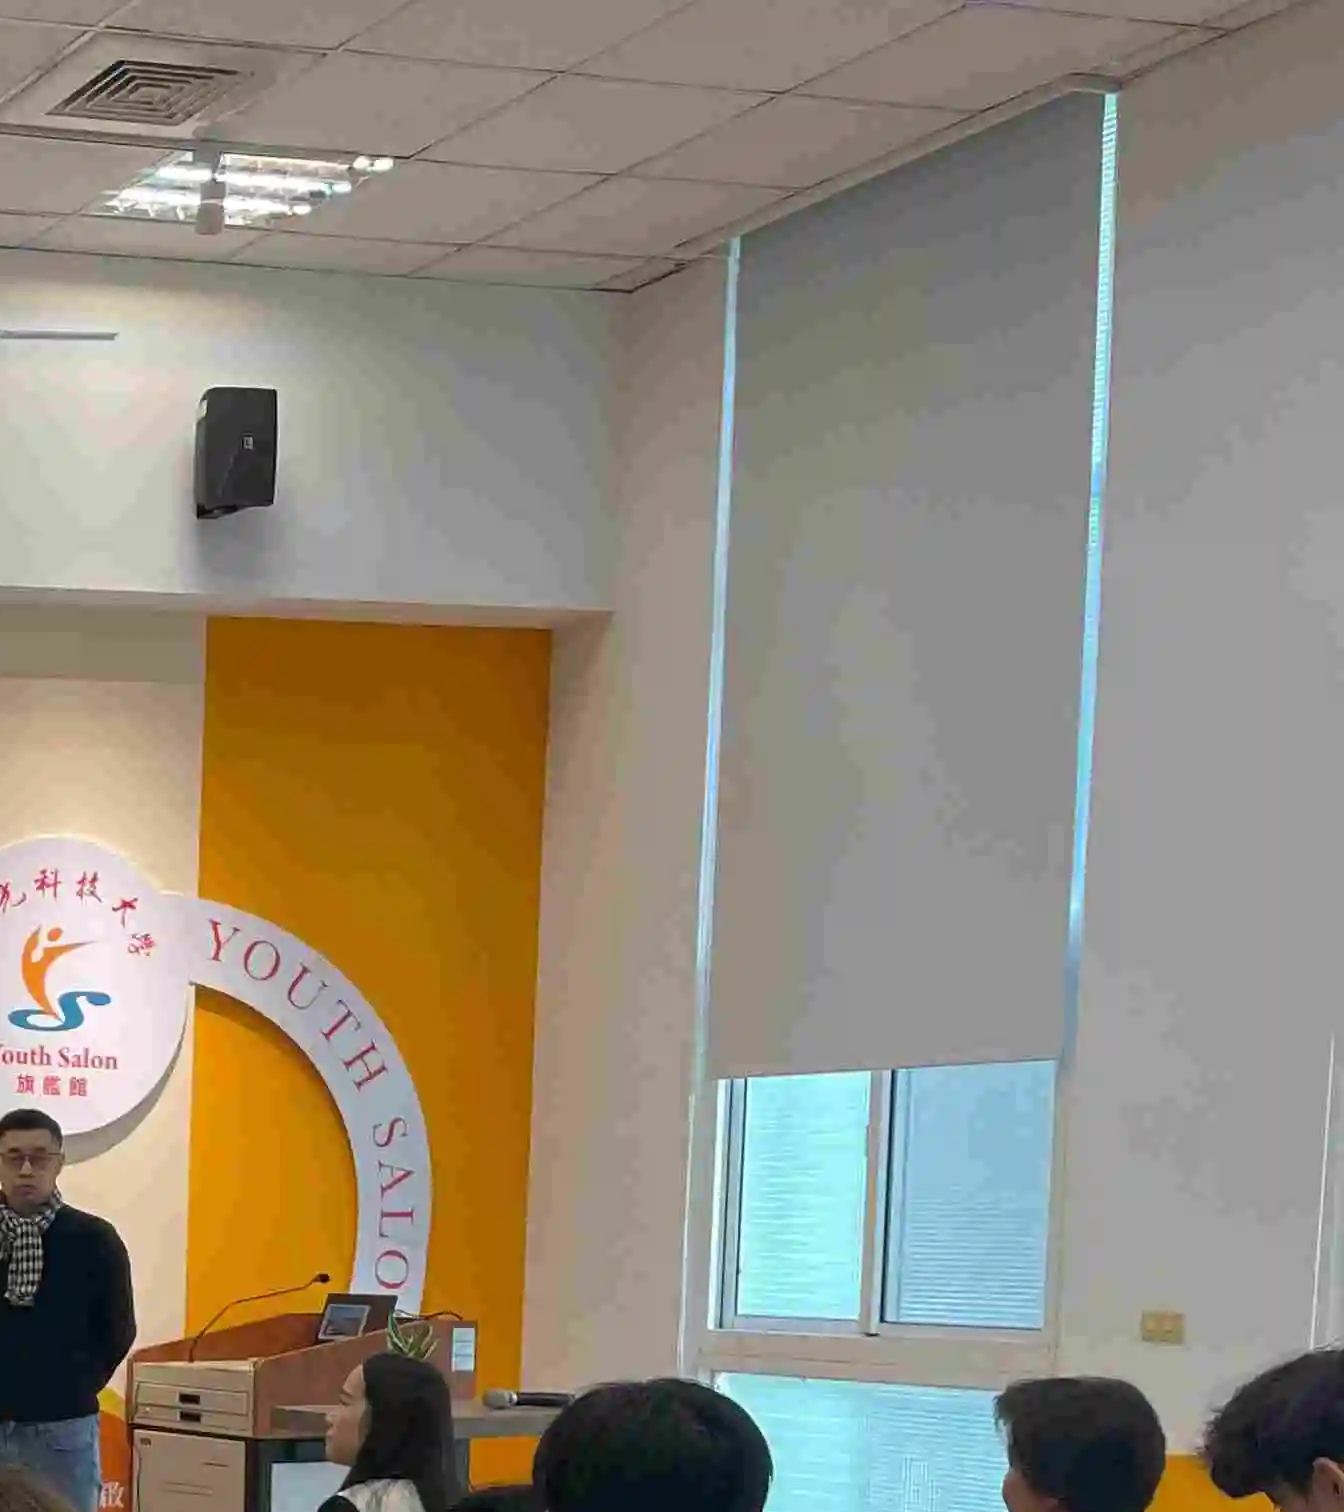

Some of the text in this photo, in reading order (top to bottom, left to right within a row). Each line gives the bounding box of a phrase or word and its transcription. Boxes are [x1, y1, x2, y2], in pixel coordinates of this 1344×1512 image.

[58, 1046, 118, 1069] Salon
[208, 918, 415, 1290] YOUTH SALO
